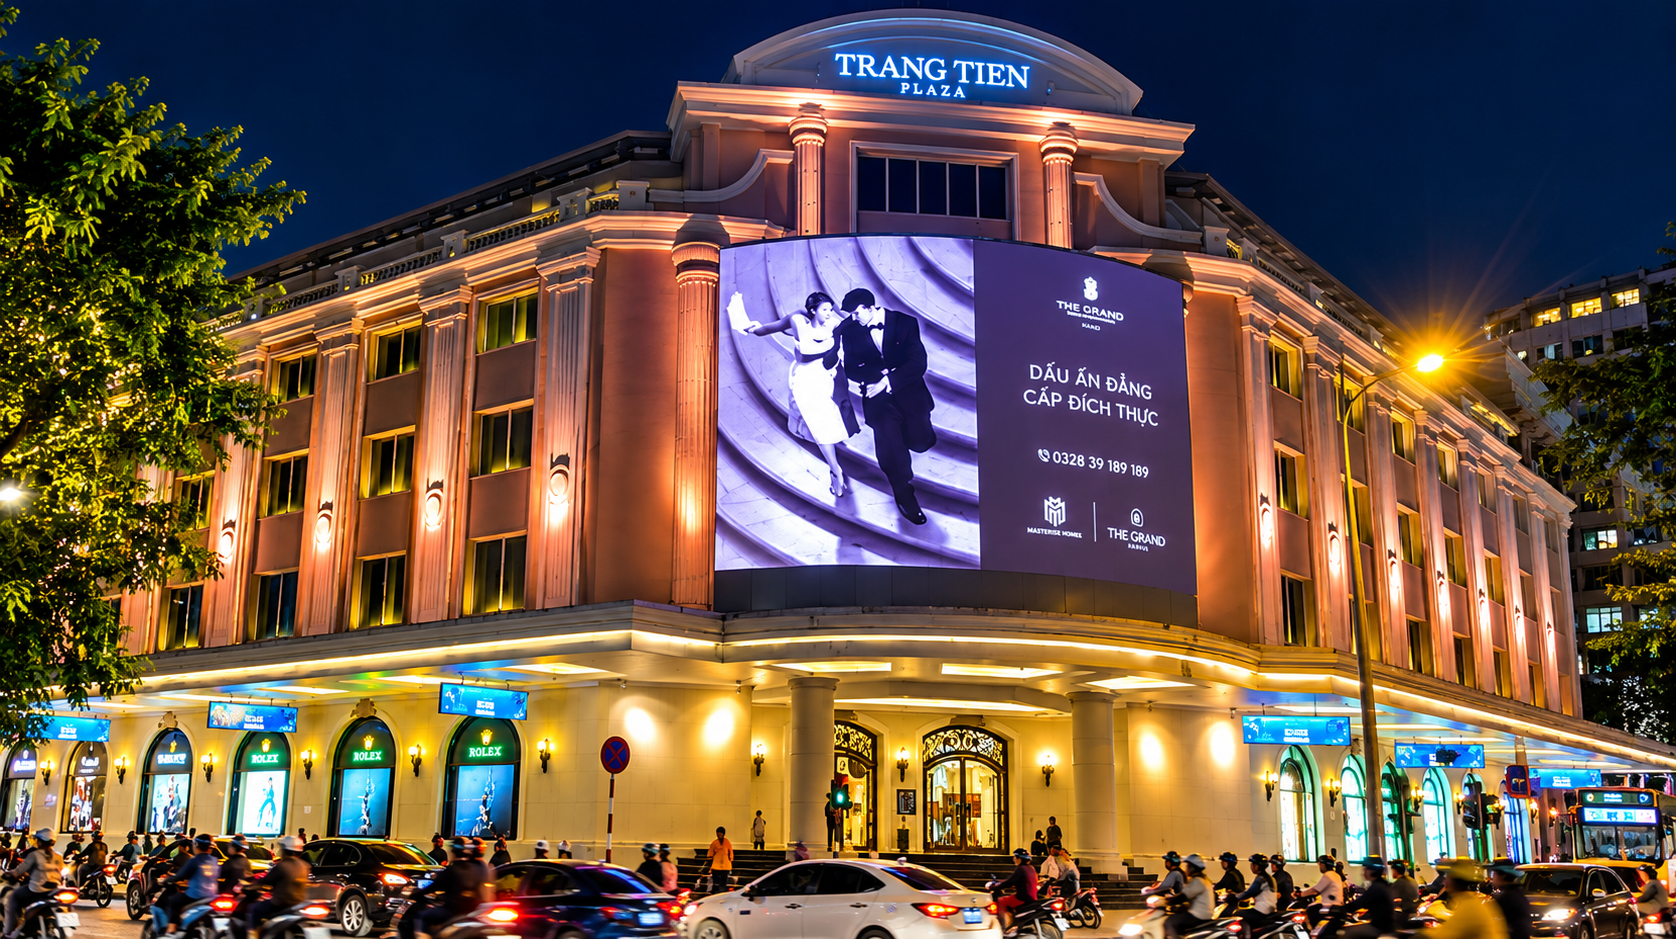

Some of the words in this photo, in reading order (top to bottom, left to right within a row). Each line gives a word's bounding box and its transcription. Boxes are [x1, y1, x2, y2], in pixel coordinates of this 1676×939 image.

[834, 53, 948, 81] TRANG
[953, 60, 1031, 89] TIEN
[900, 82, 966, 98] PLAZA
[1056, 300, 1080, 312] THE
[1083, 305, 1124, 321] GRAND
[1029, 361, 1069, 384] DẤU
[1075, 366, 1100, 390] ẤN
[1105, 372, 1152, 400] ĐẲNG
[1023, 386, 1063, 407] CẤP
[1068, 392, 1111, 417] ĐÍCH
[1115, 402, 1159, 427] THỰC
[1052, 451, 1085, 467] 0328
[1088, 456, 1104, 470] 39
[1107, 459, 1128, 474] 189
[1130, 464, 1149, 478] 189
[1107, 527, 1129, 541] THE
[1130, 530, 1166, 547] GRAND
[251, 753, 279, 764] ROLEX
[353, 750, 382, 762] ROLEX
[469, 746, 502, 758] ROLEX
